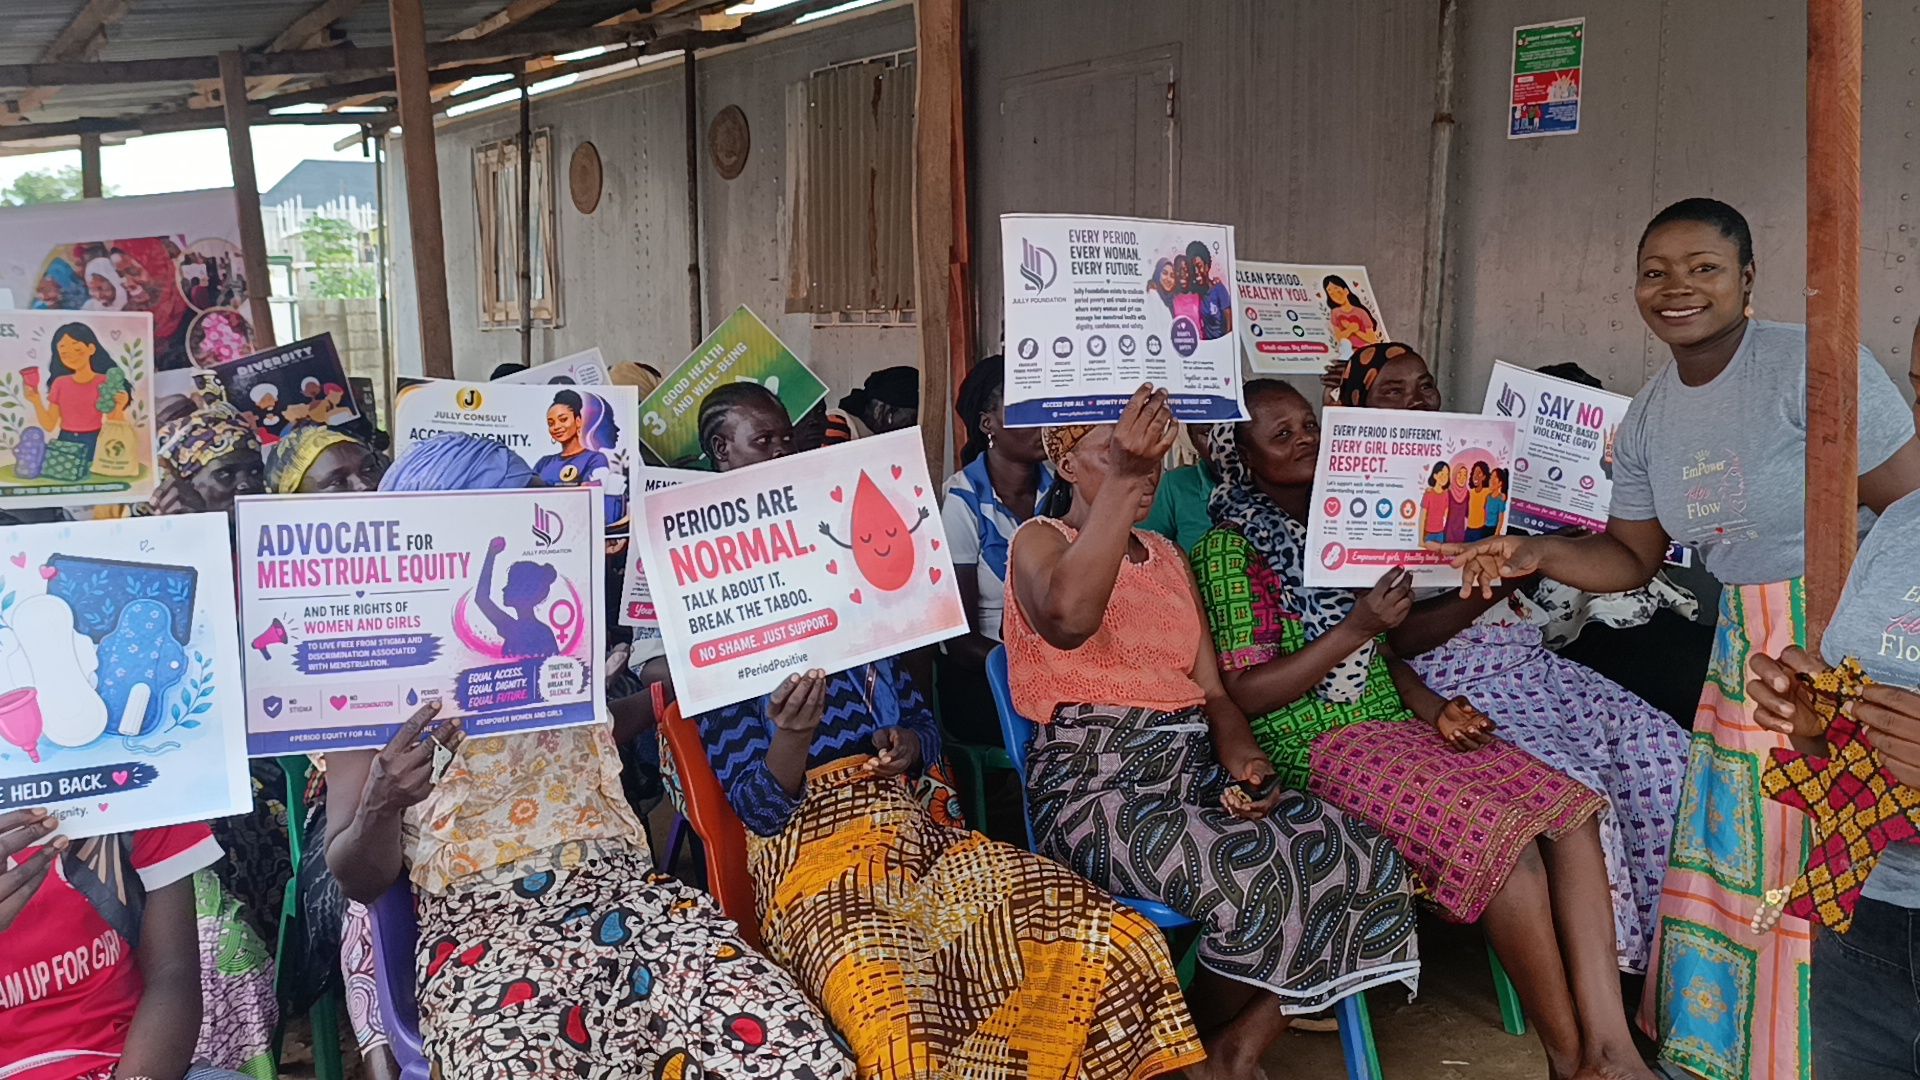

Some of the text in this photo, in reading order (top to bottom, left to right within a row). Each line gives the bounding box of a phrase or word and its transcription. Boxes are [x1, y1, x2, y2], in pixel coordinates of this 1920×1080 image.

[1069, 229, 1139, 246] EVERY PERIOD.
[1070, 246, 1141, 260] EVERY WOMAN.
[1072, 262, 1142, 276] EVERY FUTURE.
[1236, 270, 1303, 286] CLEAN PERIOD.
[1030, 296, 1066, 304] FOUNDATION
[1238, 284, 1311, 302] HEALTHY YOU.
[236, 346, 313, 376] DIVERSITY
[662, 344, 725, 406] GOOD HEALTH
[672, 342, 748, 417] AND WELL-BEING
[464, 390, 476, 407] J
[434, 411, 508, 422] JULLY CONSULT
[1538, 391, 1604, 430] SAY NO
[643, 411, 667, 436] 3
[1535, 416, 1599, 440] TO GENDER-BASED
[1333, 425, 1442, 441] EVERY PERIOD IS DIFFERENT.
[1533, 425, 1597, 450] VIOLENCE (GBV)
[1331, 440, 1442, 457] EVERY GIRL DESERVES
[1329, 455, 1388, 473] RESPECT.
[1682, 460, 1726, 480] EmPower
[663, 485, 798, 541] PERIODS ARE
[1687, 502, 1721, 519] Flow
[257, 520, 433, 557] ADVOCATE FOR
[669, 520, 816, 586] NORMAL.
[1352, 552, 1386, 562] Empowered
[257, 552, 470, 589] MENSTRUAL EQUITY
[682, 572, 786, 612] TALK ABOUT IT.
[304, 602, 408, 618] AND THE RIGHTS OF
[688, 589, 812, 635] BREAK THE TABOO.
[304, 615, 421, 634] WOMEN AND GIRLS
[319, 642, 335, 650] LIVE
[336, 640, 354, 648] FREE
[356, 639, 377, 648] FROM
[379, 638, 406, 647] STIGMA
[699, 614, 833, 662] NO SHAME. JUST SUPPORT.
[308, 647, 417, 661] DISCRIMINATION ASSOCIATED
[308, 659, 389, 671] WITH MENSTRUATION.
[738, 652, 808, 679] #PeriodPositive
[468, 667, 523, 684] EQUAL ACCESS.
[560, 671, 572, 679] CAN
[468, 678, 528, 695] EQUAL DIGNITY.
[548, 680, 563, 688] BREAK
[468, 695, 494, 708] EQUAL
[511, 713, 533, 722] WOMEN
[547, 710, 563, 718] GIRLS
[322, 731, 347, 740] EQUITY
[349, 730, 362, 738] FOR
[10, 780, 53, 802] HELD
[59, 773, 107, 796] BACK.
[51, 806, 88, 822] dignity.
[23, 961, 50, 1001] UP
[52, 946, 90, 991] FOR
